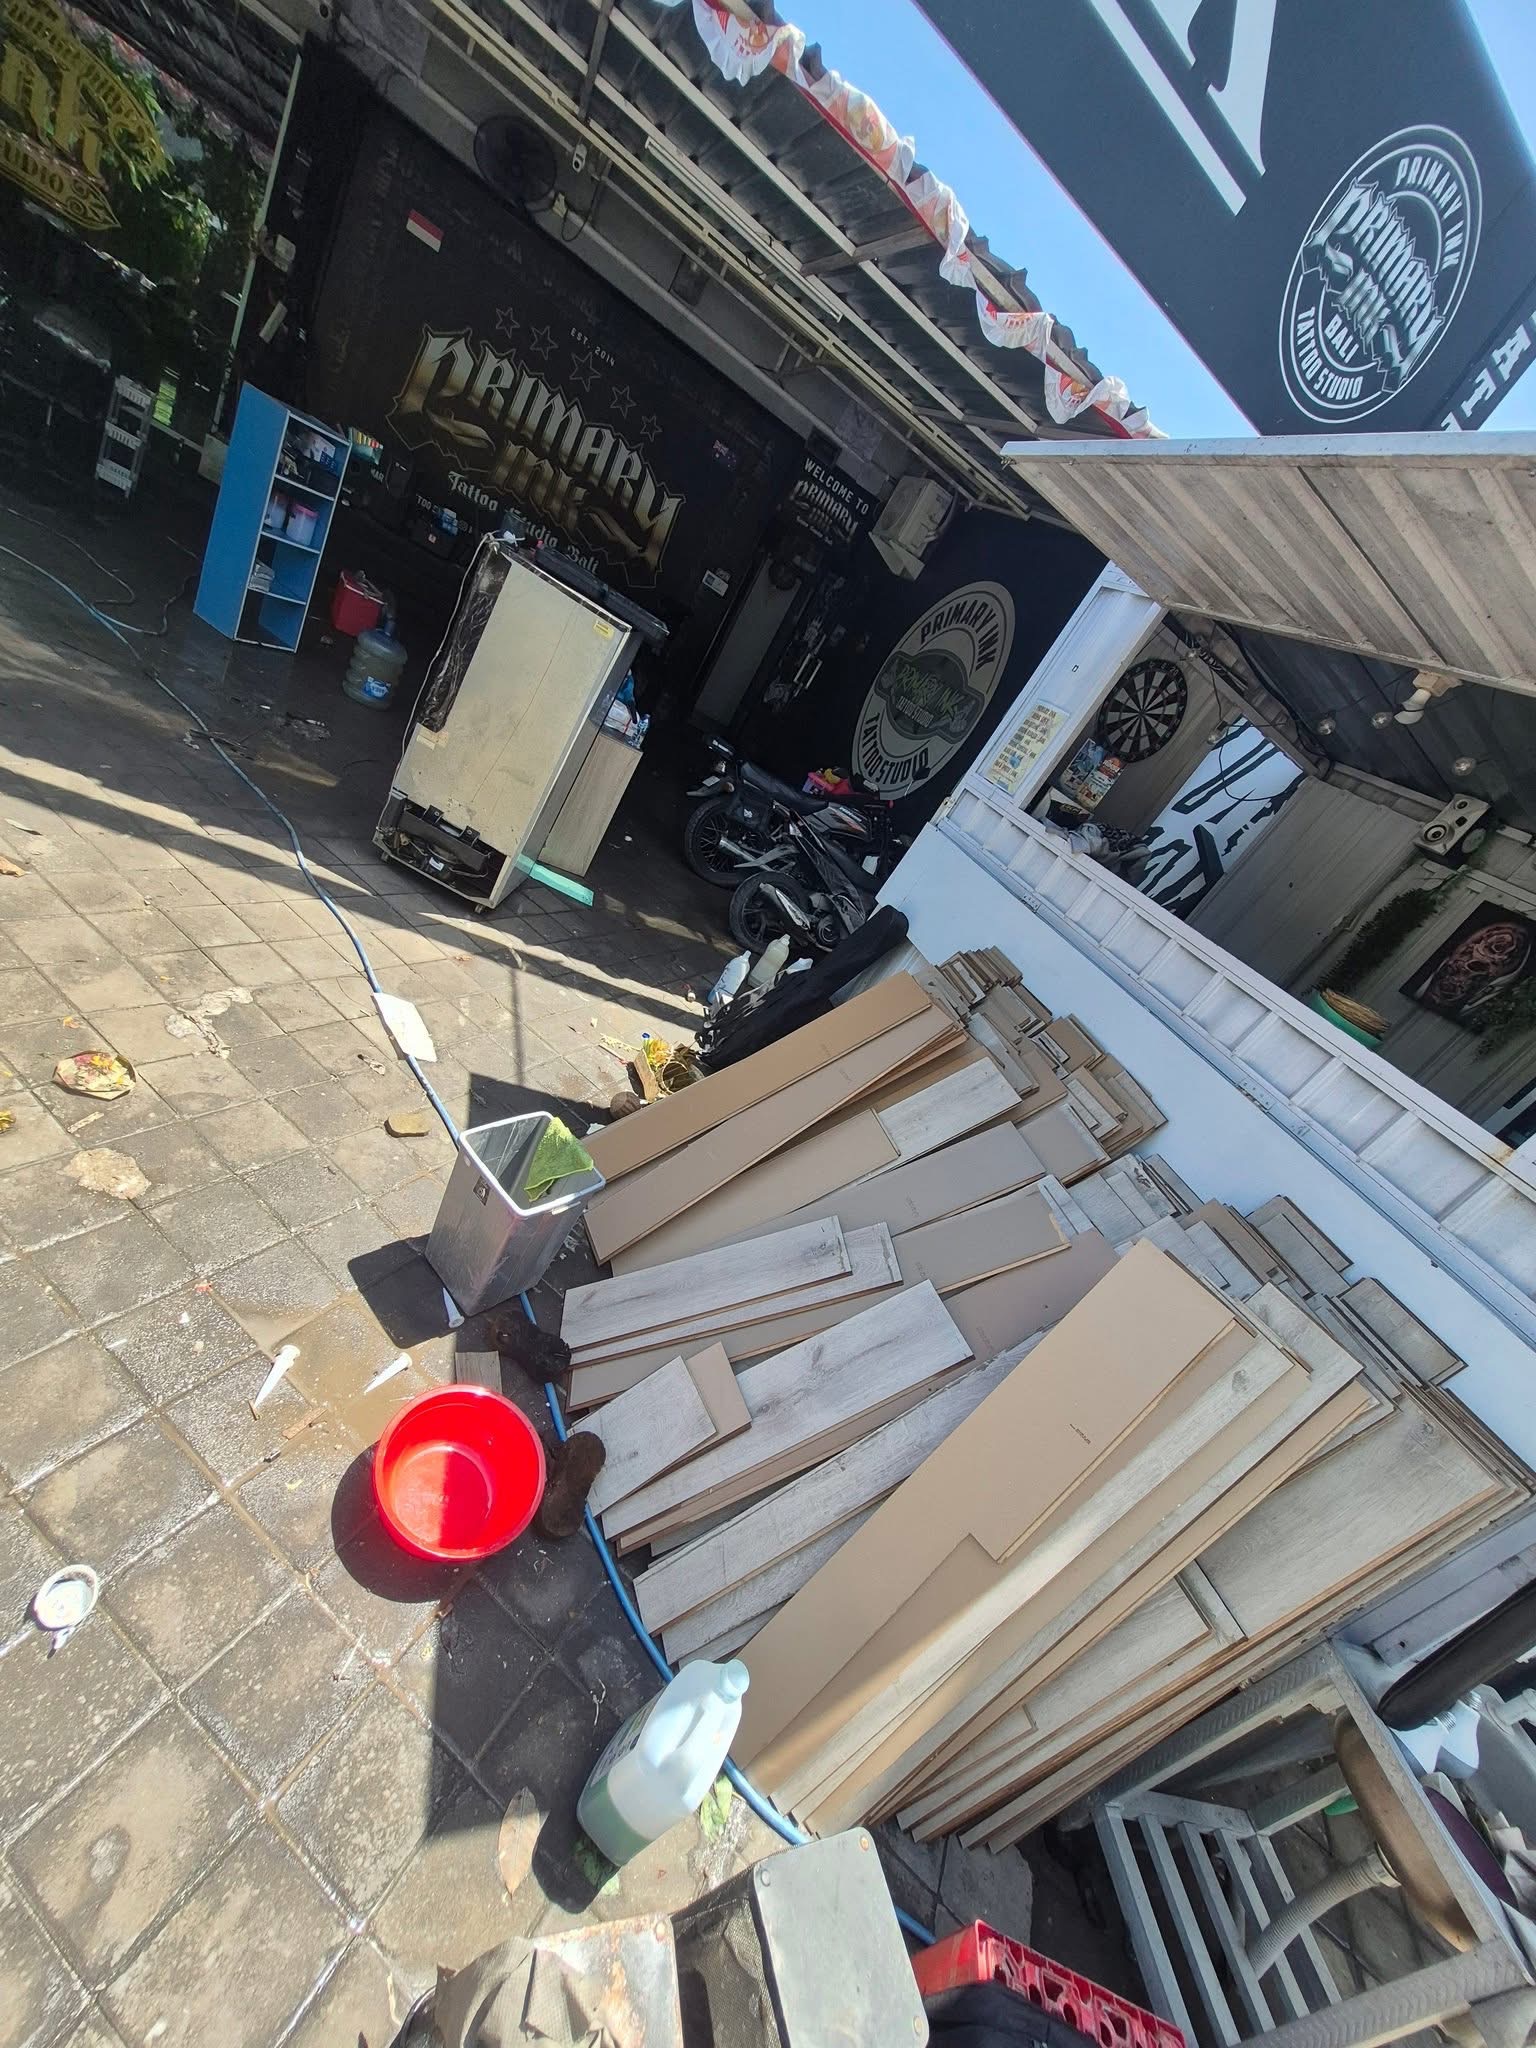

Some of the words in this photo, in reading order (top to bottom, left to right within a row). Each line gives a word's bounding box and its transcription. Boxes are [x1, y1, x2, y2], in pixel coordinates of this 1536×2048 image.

[1395, 156, 1463, 219] PRIMARY
[1441, 219, 1465, 271] INK
[1304, 182, 1444, 380] PRIMARY
[1296, 306, 1323, 381] TATTOO
[1313, 367, 1364, 400] STUDIO
[1324, 313, 1360, 364] BALI
[400, 330, 684, 570] PRIMARY
[803, 457, 855, 504] WELCOME
[855, 496, 870, 516] TO
[448, 470, 499, 512] Tattoo
[920, 599, 998, 646] PRIMARY
[975, 622, 1000, 673] INK
[861, 712, 885, 778] TATTOO
[874, 746, 930, 786] STUDIO
